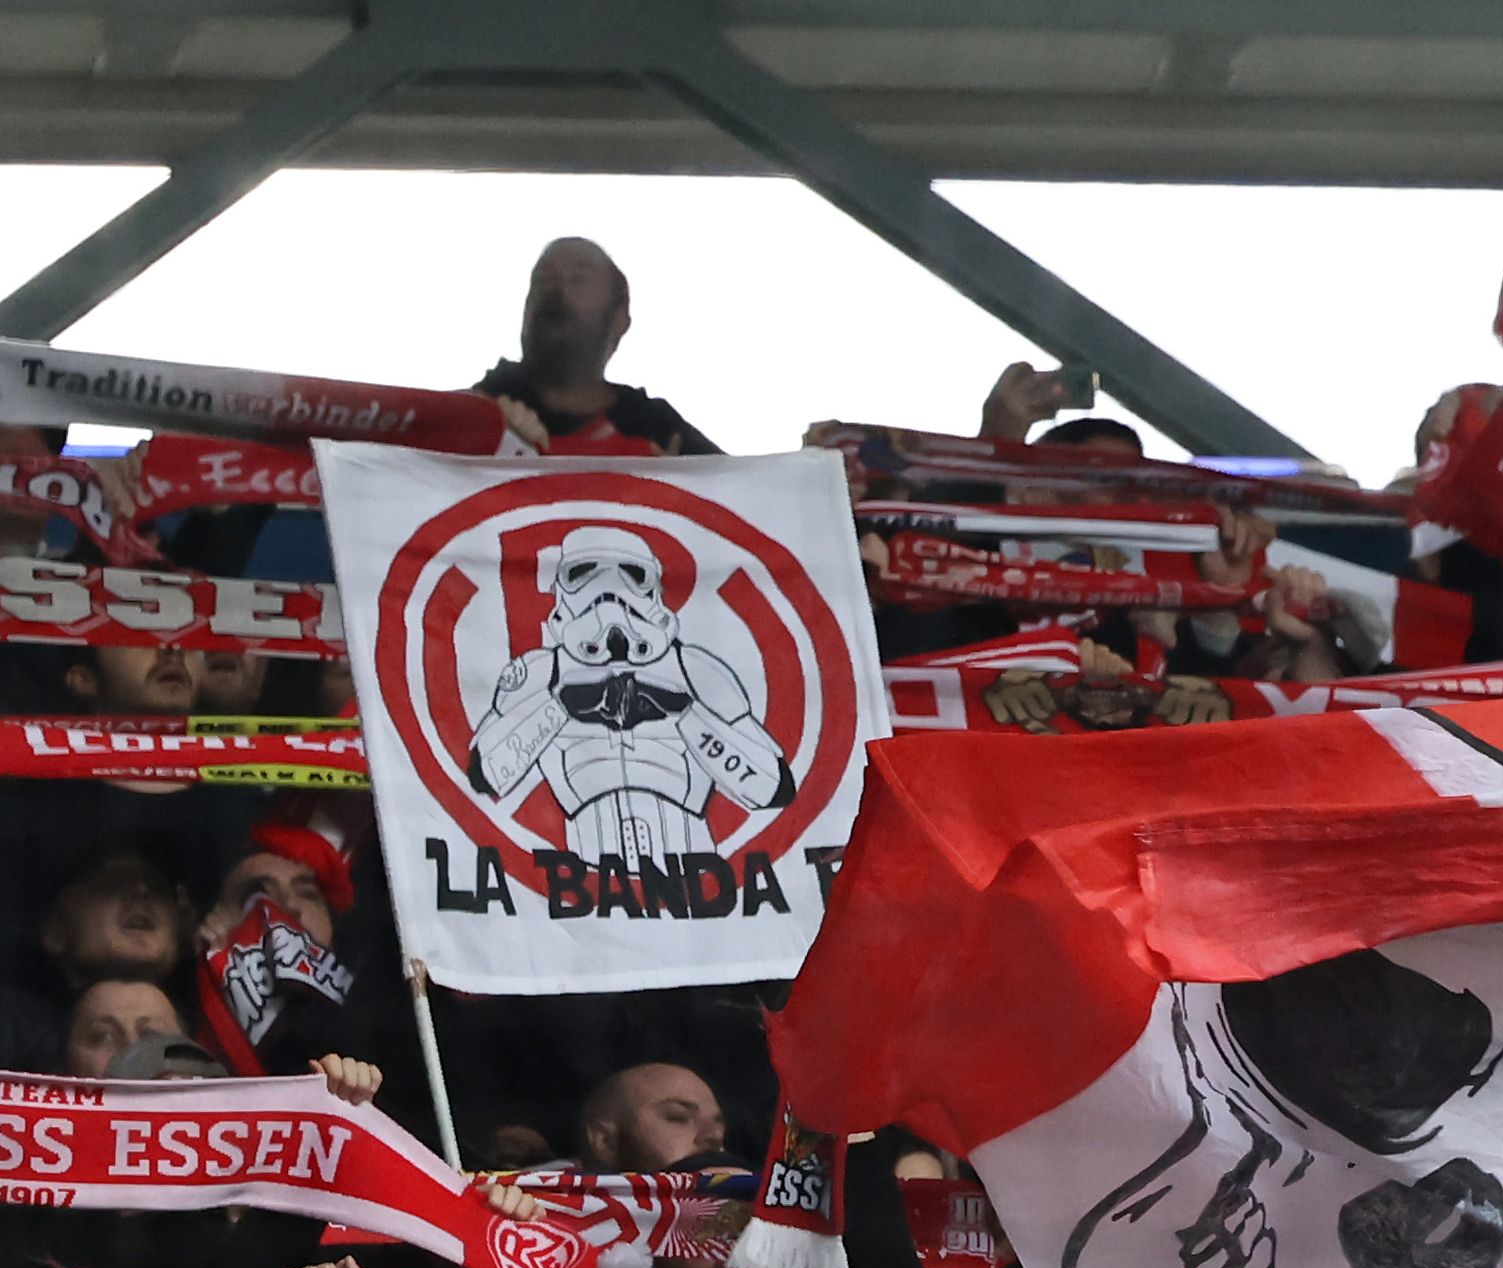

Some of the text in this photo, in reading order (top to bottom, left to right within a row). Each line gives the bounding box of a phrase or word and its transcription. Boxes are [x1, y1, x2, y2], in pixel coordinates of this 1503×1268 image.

[20, 357, 214, 412] Tradition
[700, 730, 757, 783] 1907
[425, 837, 518, 918] LA
[532, 849, 792, 921] BANDA
[1, 1081, 105, 1107] TEAM
[108, 1119, 353, 1184] ESSEN
